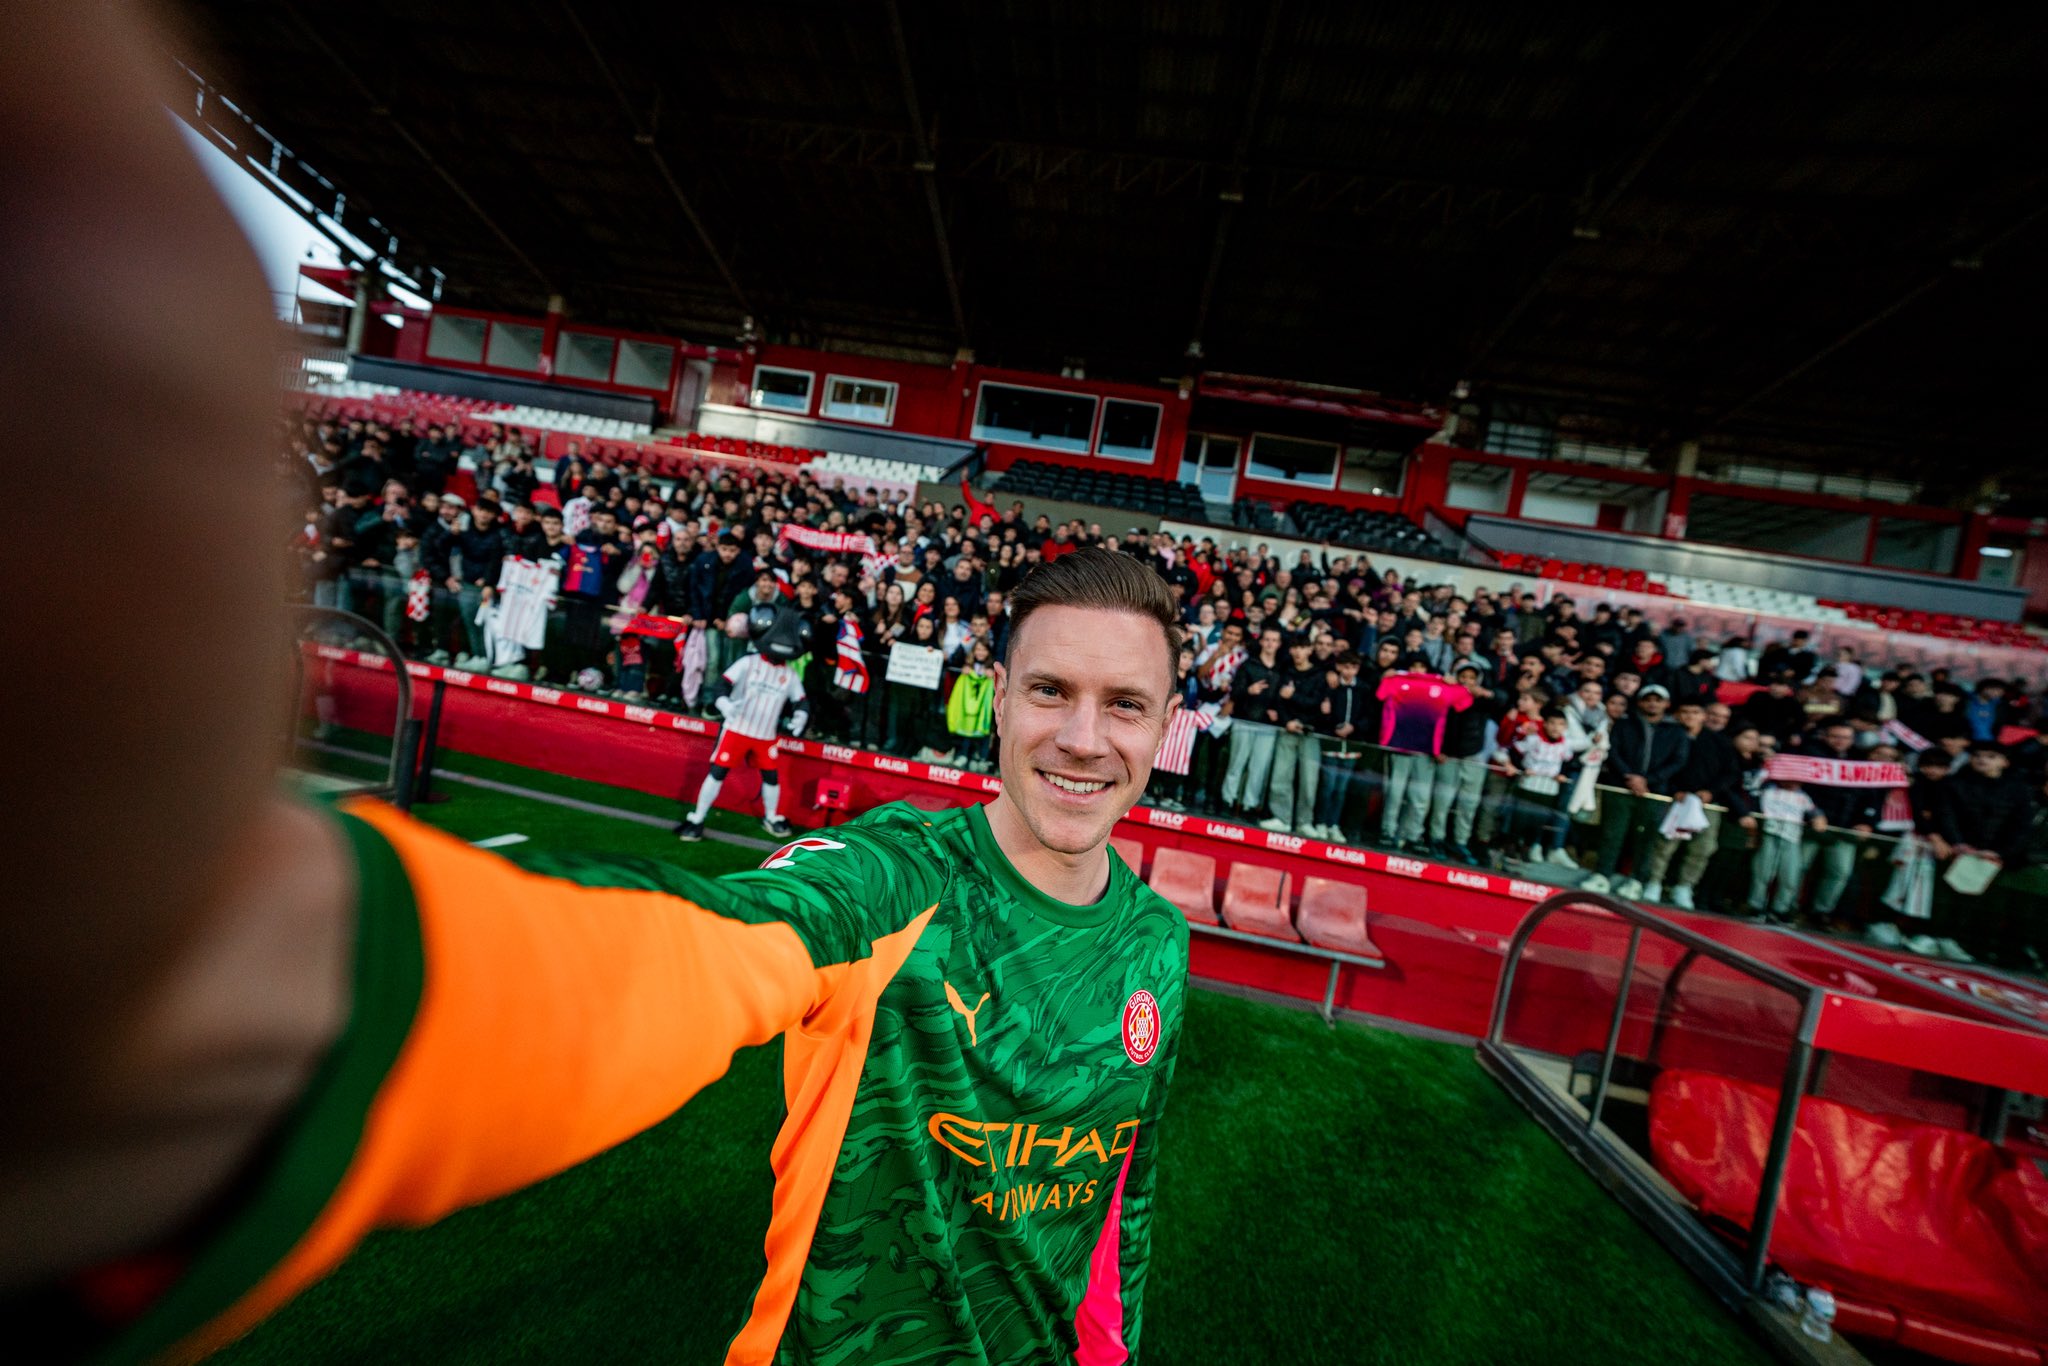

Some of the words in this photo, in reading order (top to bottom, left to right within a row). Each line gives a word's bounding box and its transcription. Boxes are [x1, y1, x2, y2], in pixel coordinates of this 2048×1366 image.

[672, 717, 705, 732] LALIGA
[776, 738, 804, 752] ALIGA
[874, 757, 909, 773] LALIGA
[1206, 823, 1245, 841] LALIGA
[1326, 846, 1366, 865] LALIGA
[1447, 870, 1489, 889] LALIGA
[1129, 993, 1155, 1010] GIRONA
[928, 1112, 1140, 1173] ETIHAD
[971, 1180, 1098, 1221] AIRWAYS
